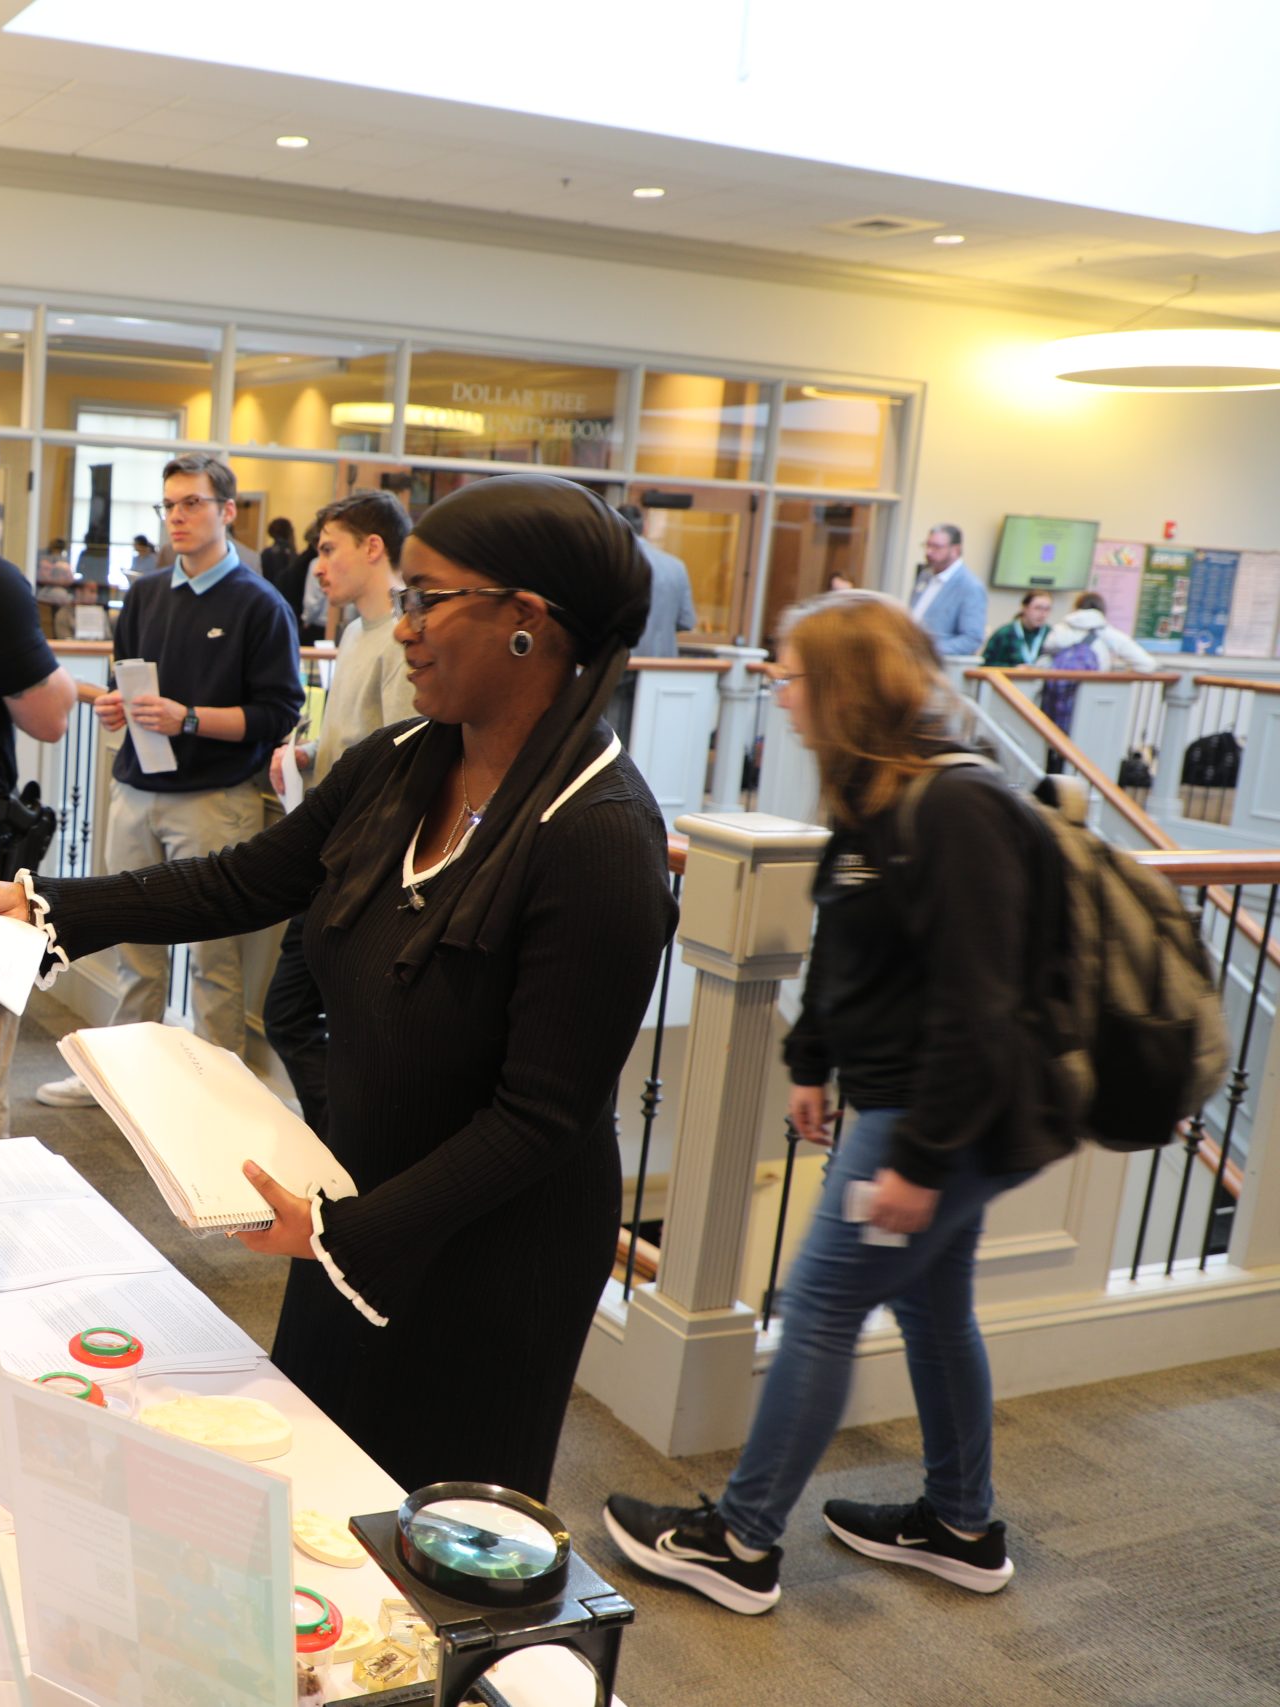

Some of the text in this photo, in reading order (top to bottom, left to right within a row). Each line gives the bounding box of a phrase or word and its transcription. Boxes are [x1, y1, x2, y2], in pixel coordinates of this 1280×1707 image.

[451, 382, 587, 413] DOLLAR TREE
[553, 418, 617, 443] ROOM
